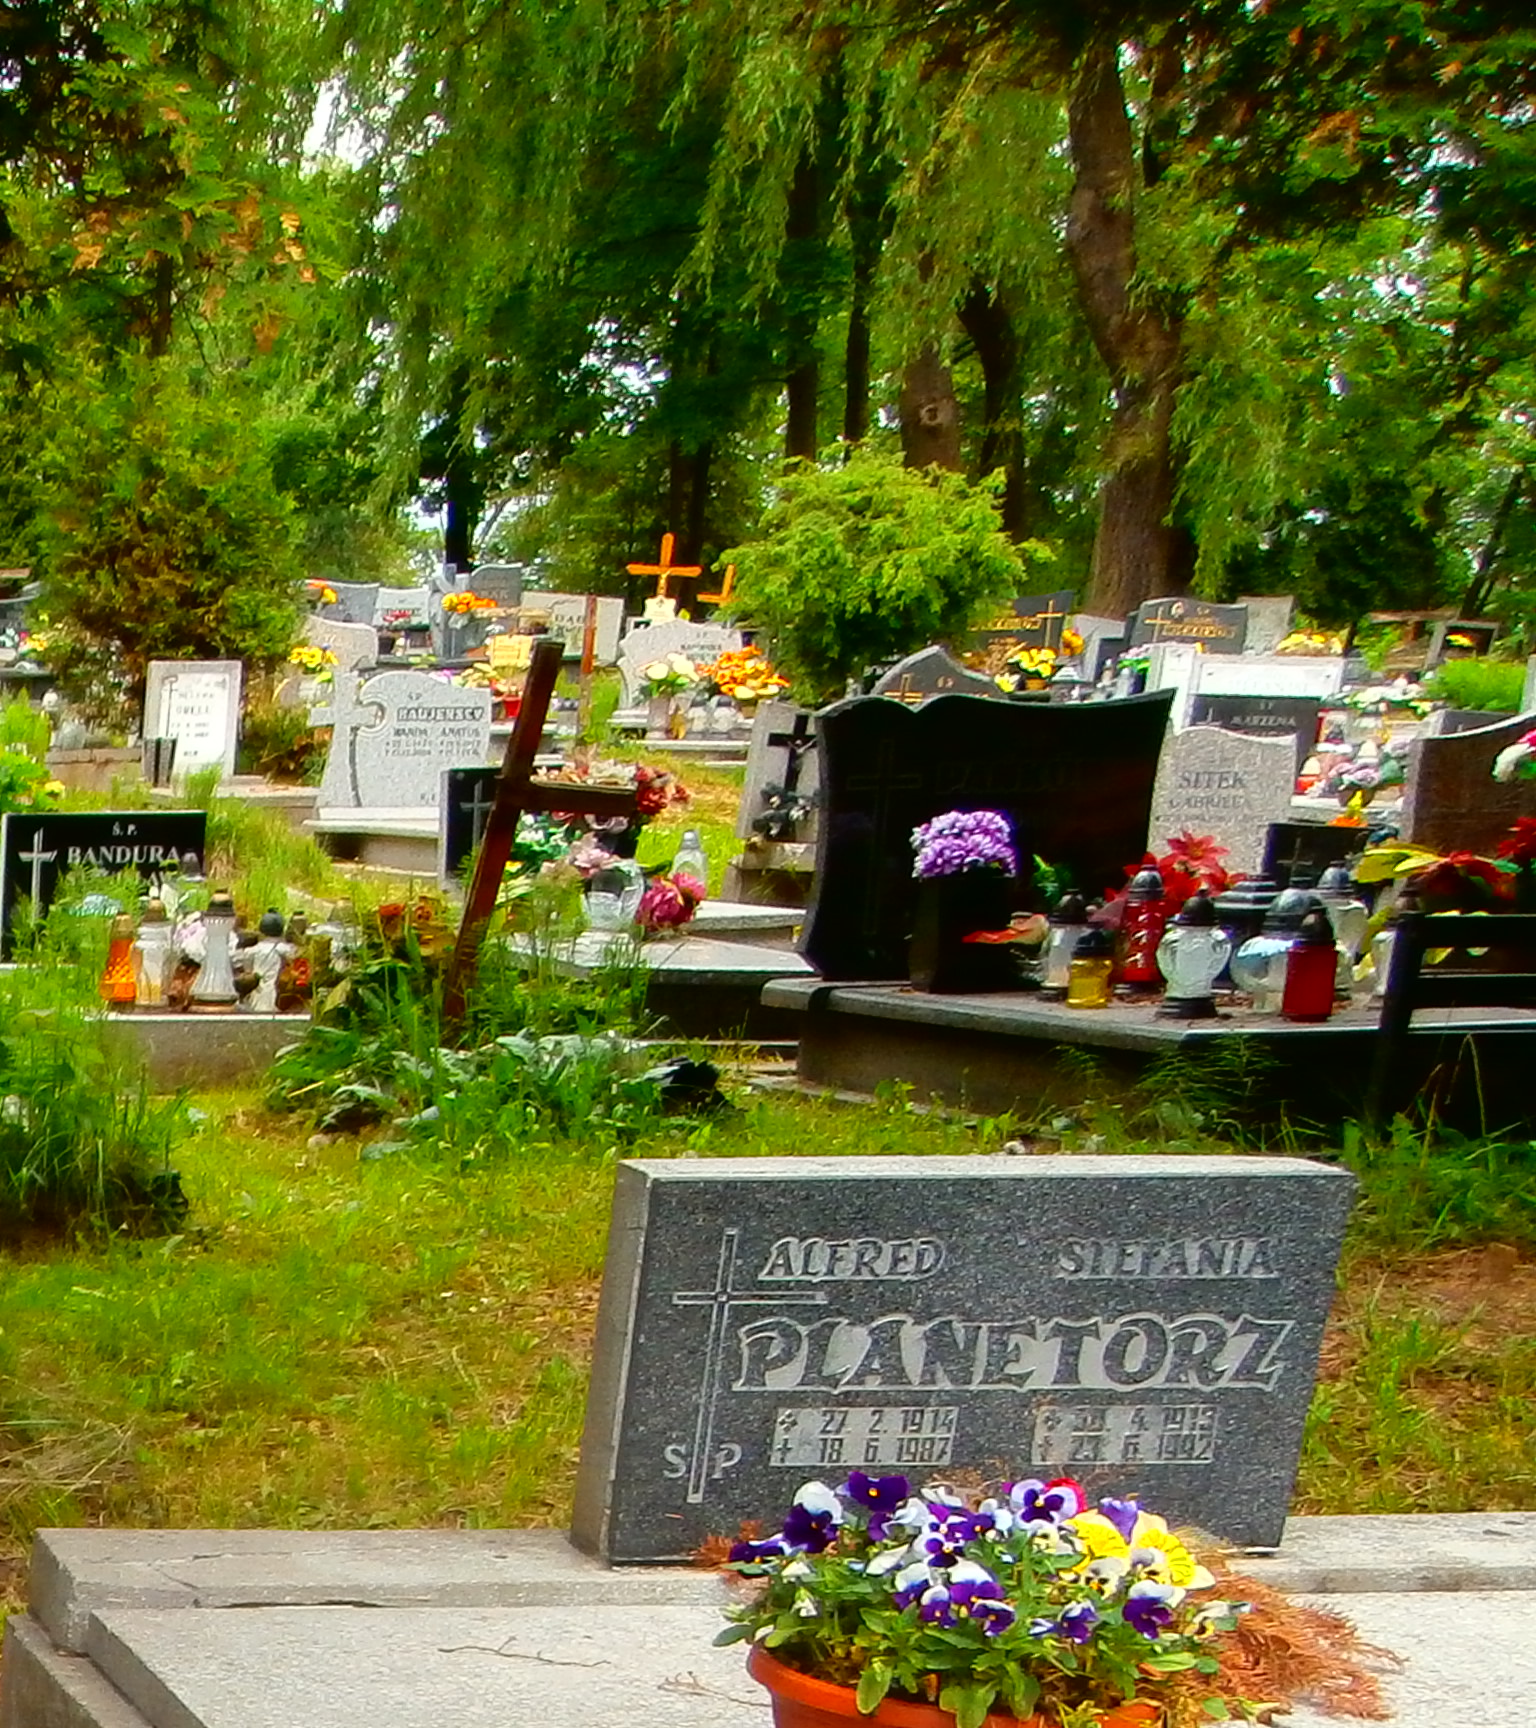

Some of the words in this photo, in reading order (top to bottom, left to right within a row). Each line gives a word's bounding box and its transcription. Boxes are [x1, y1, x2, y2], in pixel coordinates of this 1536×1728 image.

[67, 844, 180, 865] BANDURA
[757, 1237, 946, 1282] ALFRED
[732, 1312, 1298, 1394] PLANETORZ
